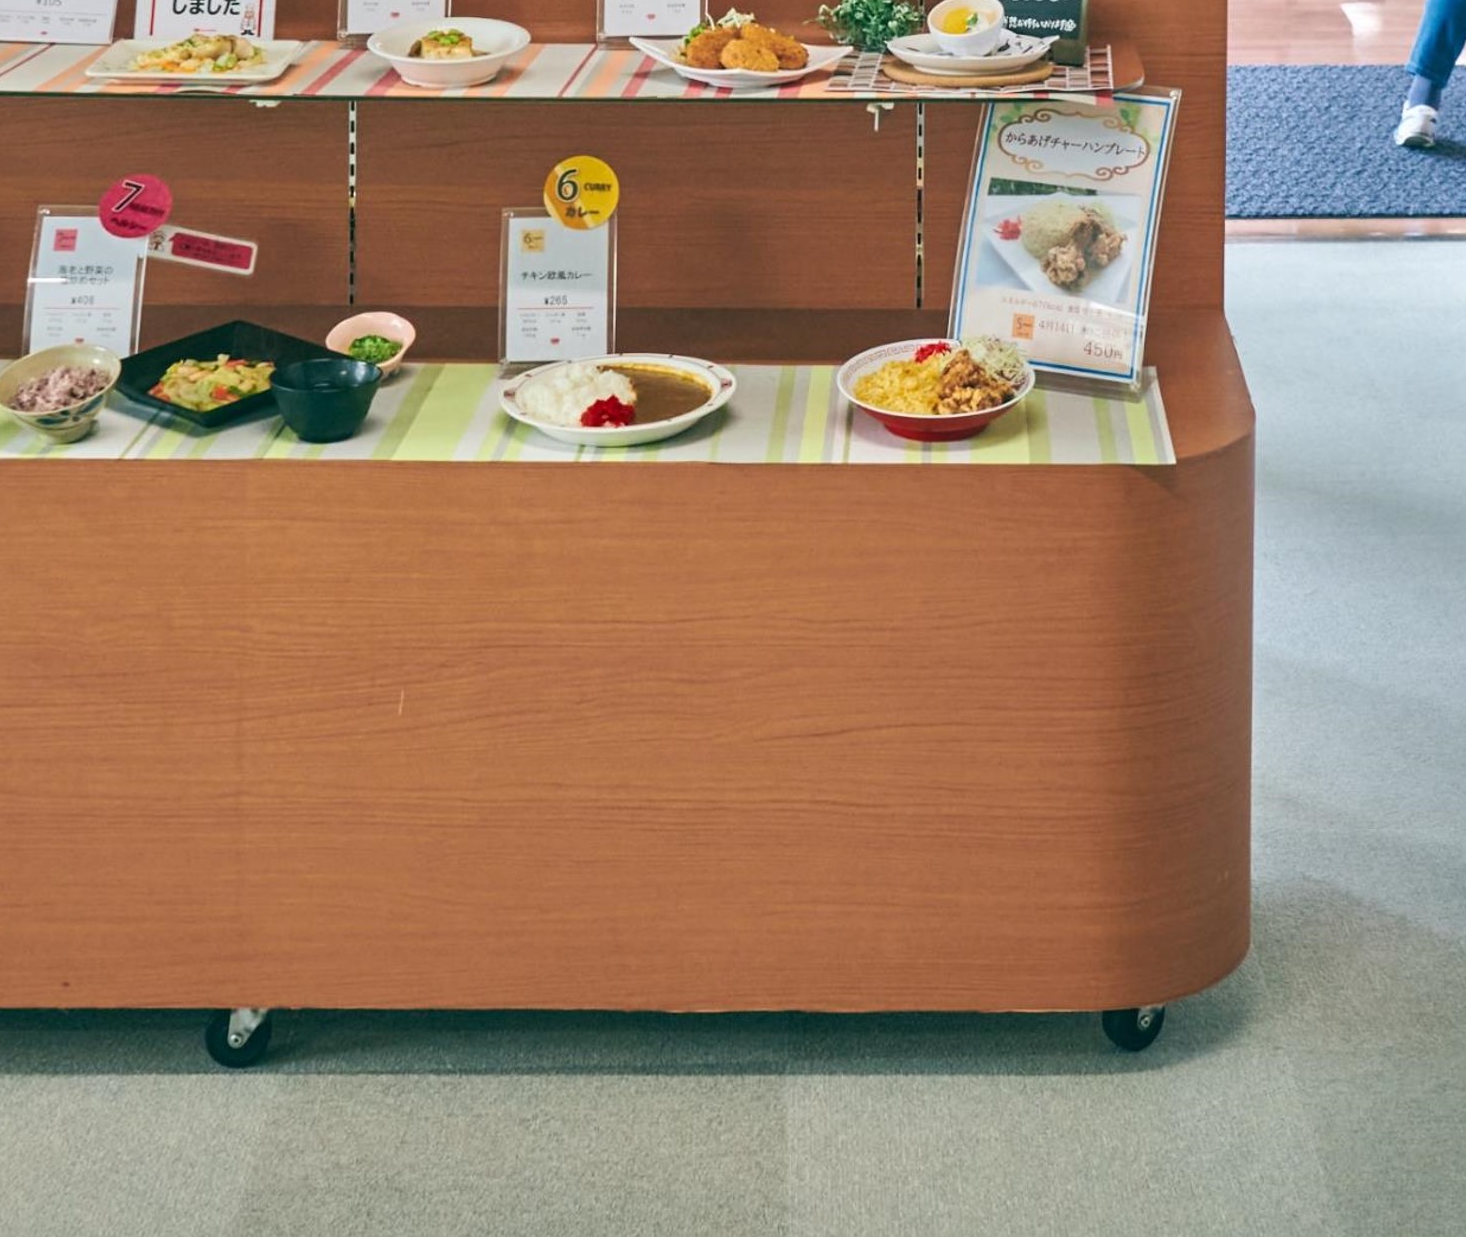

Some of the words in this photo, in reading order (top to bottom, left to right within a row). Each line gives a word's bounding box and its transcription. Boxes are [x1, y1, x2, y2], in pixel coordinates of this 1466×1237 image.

[1004, 130, 1146, 158] からあげチャーハンプレート
[111, 179, 146, 213] 7
[557, 168, 579, 202] 6
[583, 181, 613, 192] CURRY
[564, 206, 600, 219] カレー
[520, 270, 594, 281] チキン欧風カレー
[1083, 339, 1123, 361] 450円
